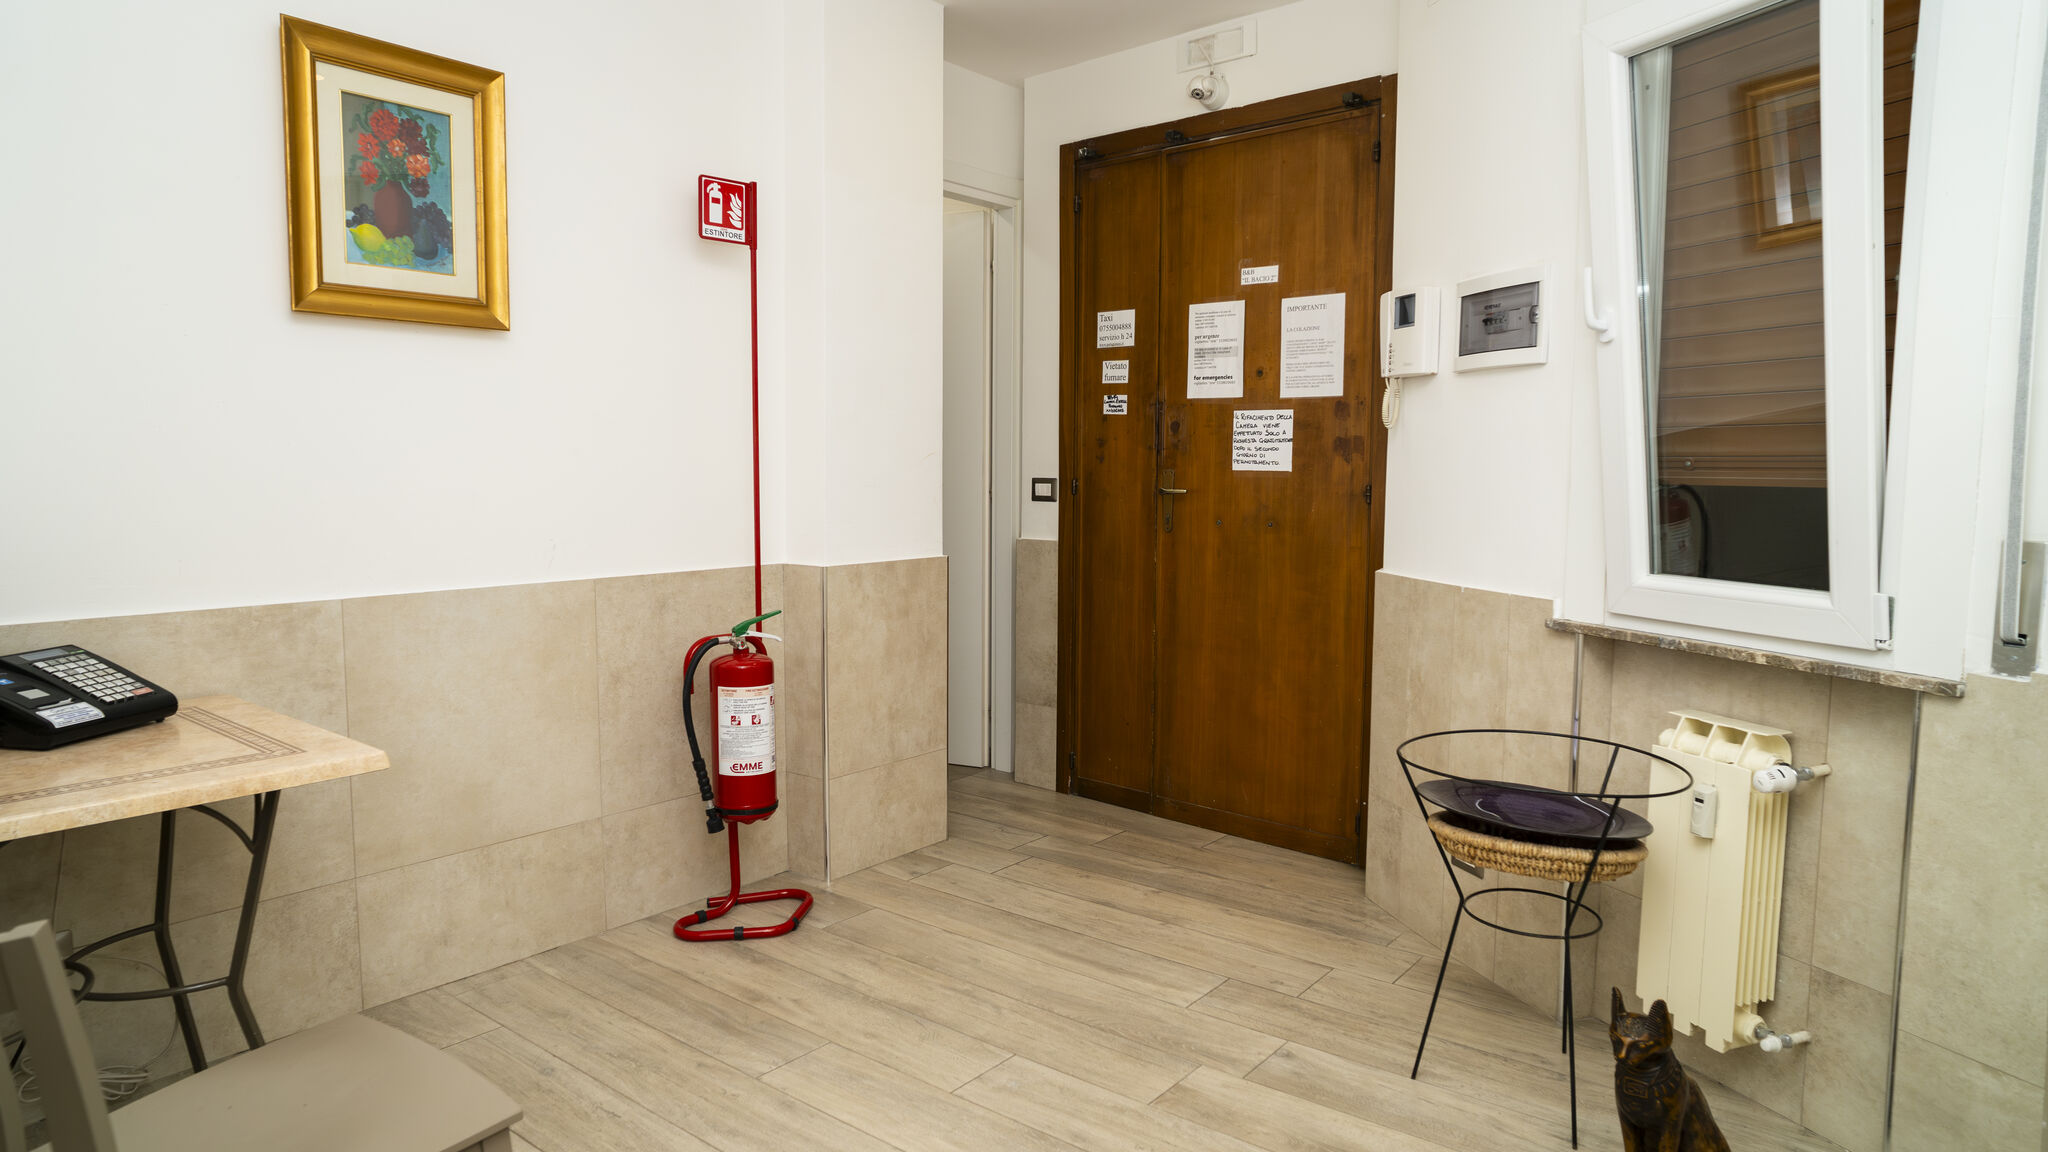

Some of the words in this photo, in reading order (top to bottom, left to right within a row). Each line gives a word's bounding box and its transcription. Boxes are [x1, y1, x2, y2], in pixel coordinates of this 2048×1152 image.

[704, 228, 743, 240] ESTINTORE
[1286, 303, 1328, 312] IMPORTANTE
[1100, 313, 1113, 322] Taxi
[1099, 333, 1120, 341] servizio
[1125, 332, 1133, 340] 24
[1105, 362, 1127, 370] Vietato
[1104, 373, 1127, 381] fumare
[732, 761, 763, 771] EMME
